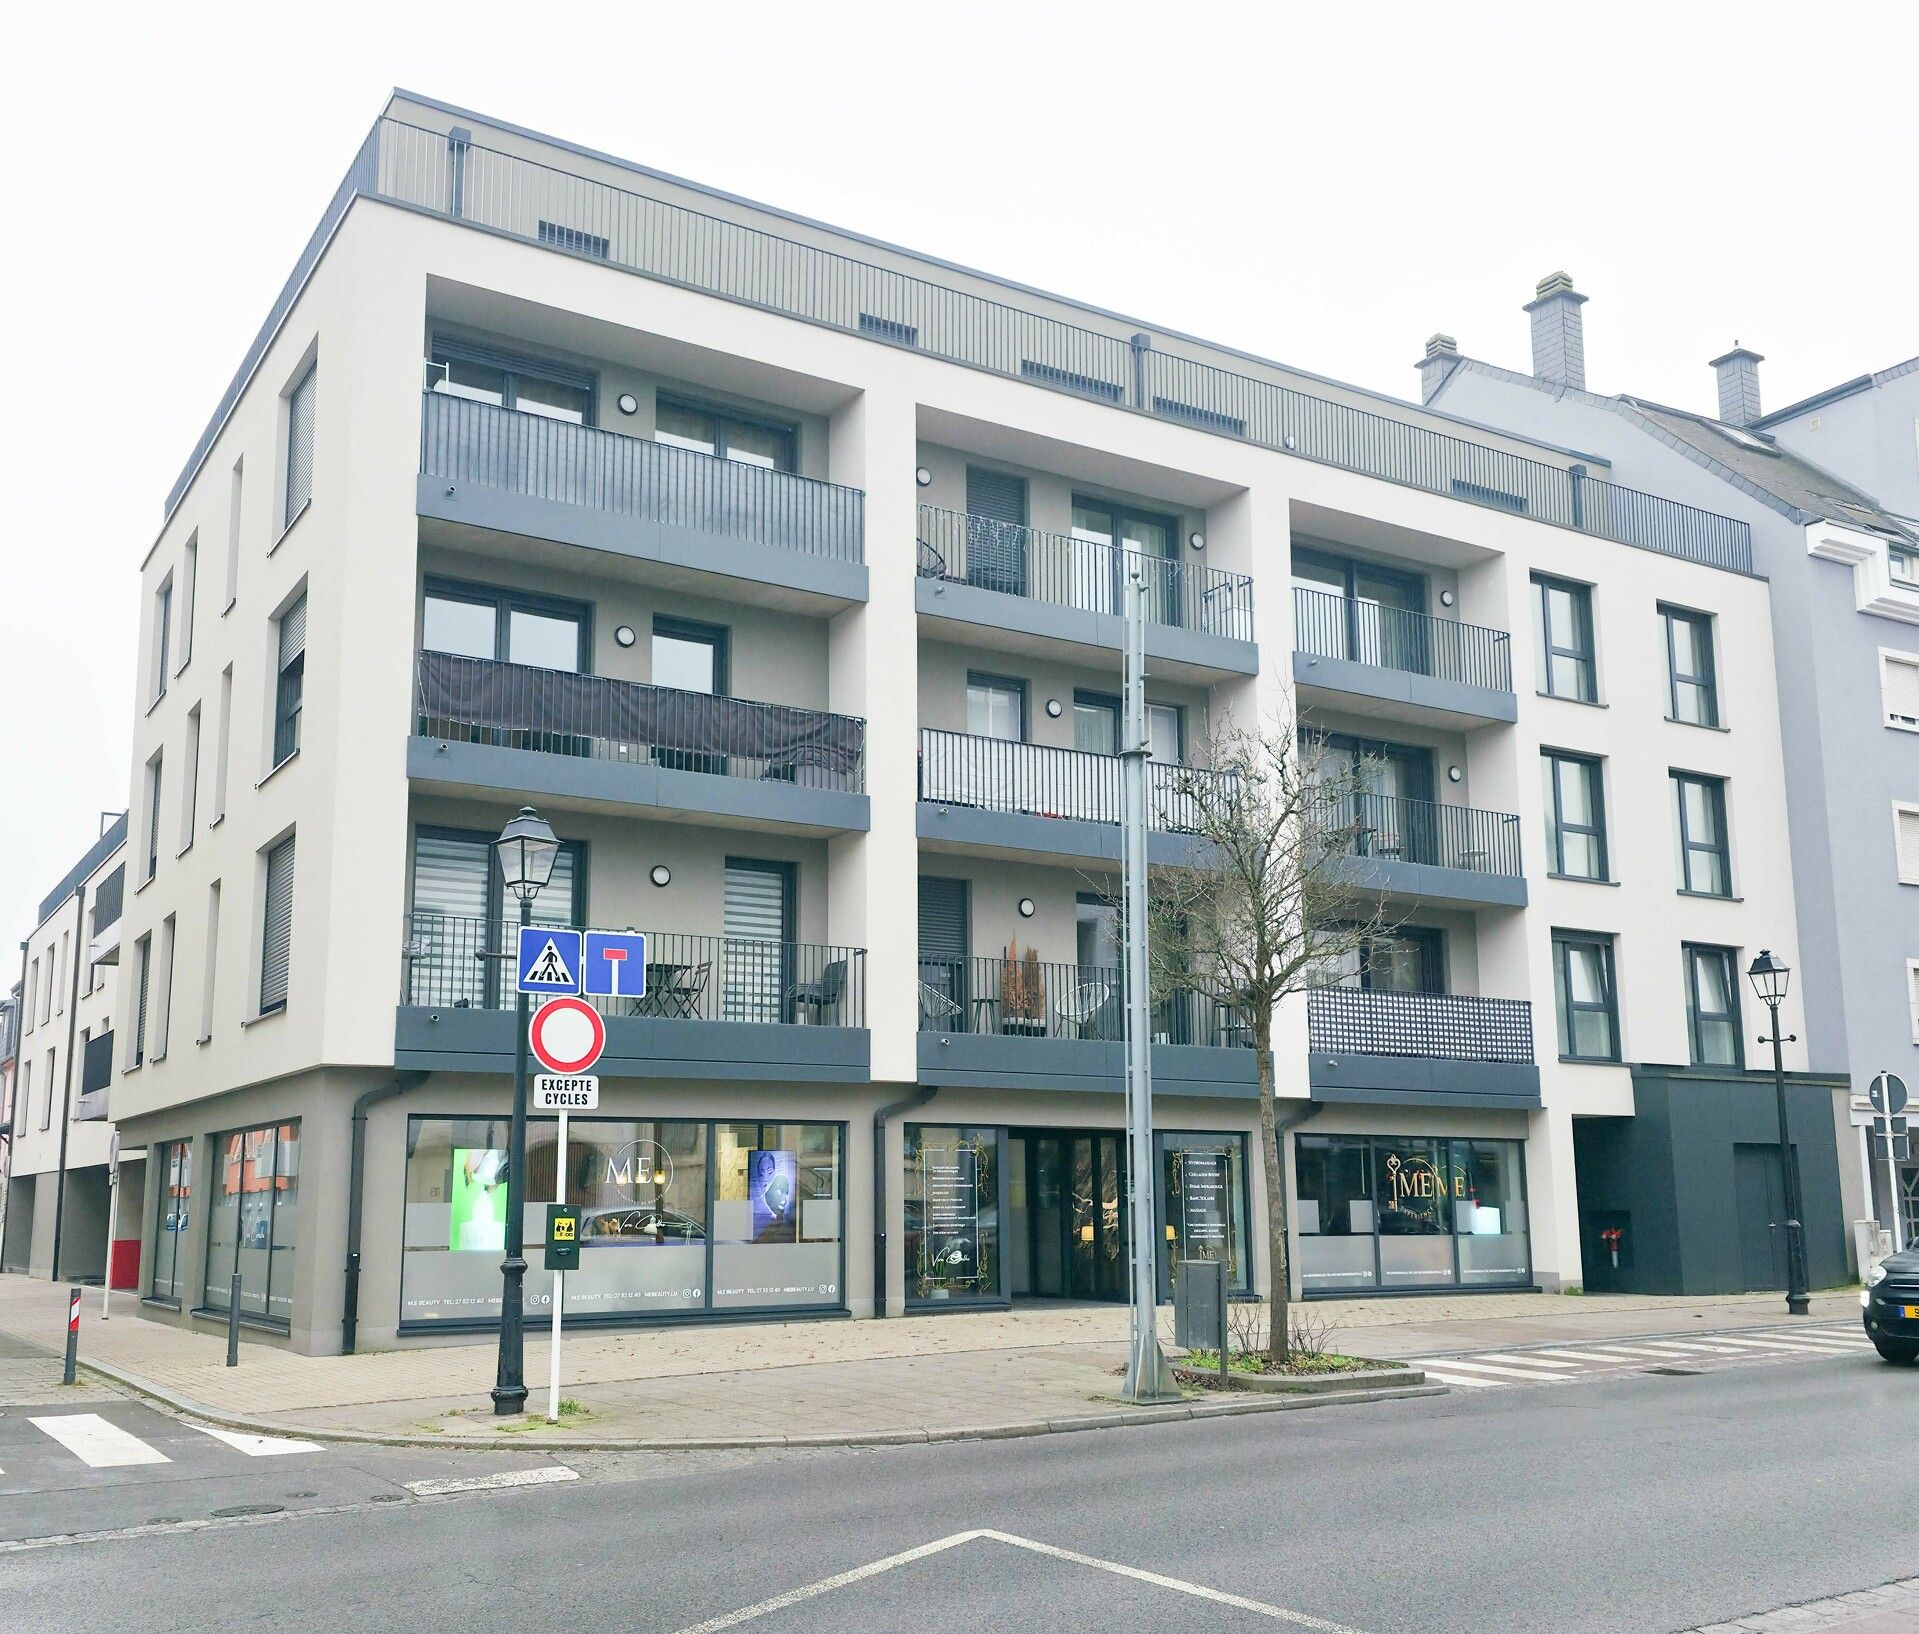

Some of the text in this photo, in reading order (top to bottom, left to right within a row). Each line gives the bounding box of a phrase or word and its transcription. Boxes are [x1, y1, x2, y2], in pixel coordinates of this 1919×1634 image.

[541, 1079, 592, 1091] EXCEPTE
[545, 1093, 588, 1105] CYCLES
[604, 1157, 652, 1184] ME
[1399, 1172, 1432, 1197] ME
